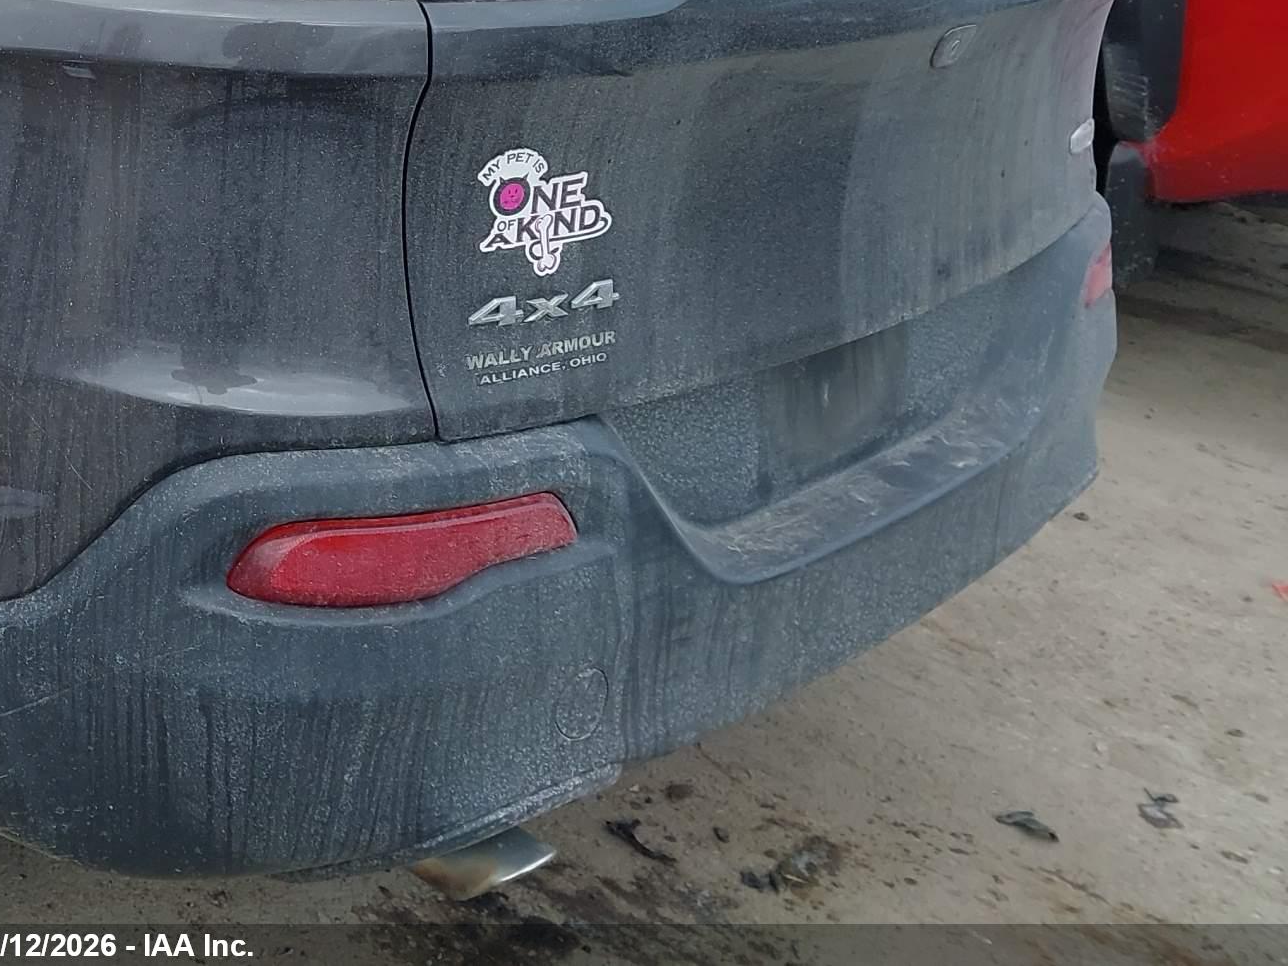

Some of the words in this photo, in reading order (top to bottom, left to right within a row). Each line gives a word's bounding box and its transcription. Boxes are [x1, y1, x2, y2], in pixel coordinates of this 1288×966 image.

[482, 159, 501, 181] MY
[507, 152, 534, 164] PET
[532, 159, 544, 174] IS
[493, 175, 585, 216] ONE
[497, 219, 516, 232] OF
[468, 278, 620, 326] 4x4
[465, 346, 533, 370] WALLY
[536, 331, 616, 359] ARMOUR
[480, 362, 566, 385] ALLIANCE,
[570, 352, 608, 368] OHIO
